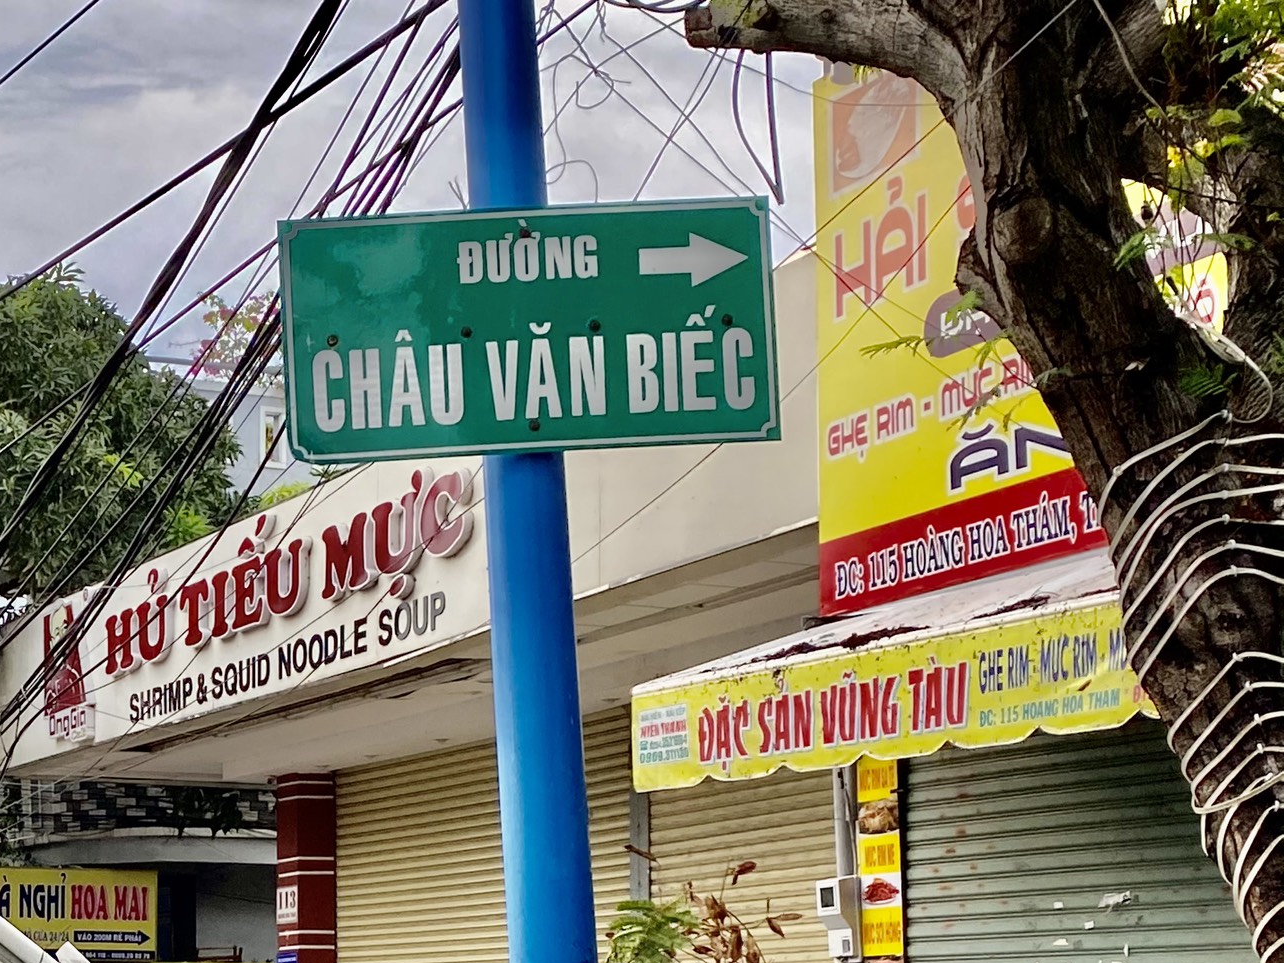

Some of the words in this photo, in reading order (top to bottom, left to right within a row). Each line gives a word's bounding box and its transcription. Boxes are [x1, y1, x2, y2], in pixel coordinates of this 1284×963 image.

[457, 219, 599, 285] ĐƯỜNG
[833, 175, 928, 319] HẢI
[312, 329, 466, 433] CHÂU
[485, 321, 606, 421] VĂN
[625, 304, 756, 414] BIẾC
[827, 414, 868, 459] GHẸ
[876, 397, 915, 440] RIM
[104, 568, 172, 676] HỦ
[180, 514, 310, 648] TIẾU
[321, 468, 472, 602] MỰC
[836, 560, 864, 598] ĐC:
[869, 551, 898, 588] 115
[903, 525, 964, 580] HOÀNG
[969, 517, 1008, 562] HOA
[129, 682, 193, 723] SHRIMP
[195, 674, 210, 701] &
[211, 652, 270, 700] SQUID
[277, 616, 369, 678] NOODLE
[376, 591, 447, 647] SOUP
[698, 696, 751, 771] ĐẶC
[820, 671, 899, 745] VŨNG
[907, 656, 968, 732] TÀU
[1000, 704, 1019, 725] 115
[18, 872, 66, 923] NGHỈ
[70, 884, 109, 921] HOA
[113, 885, 149, 921] MAI
[278, 890, 297, 911] 113
